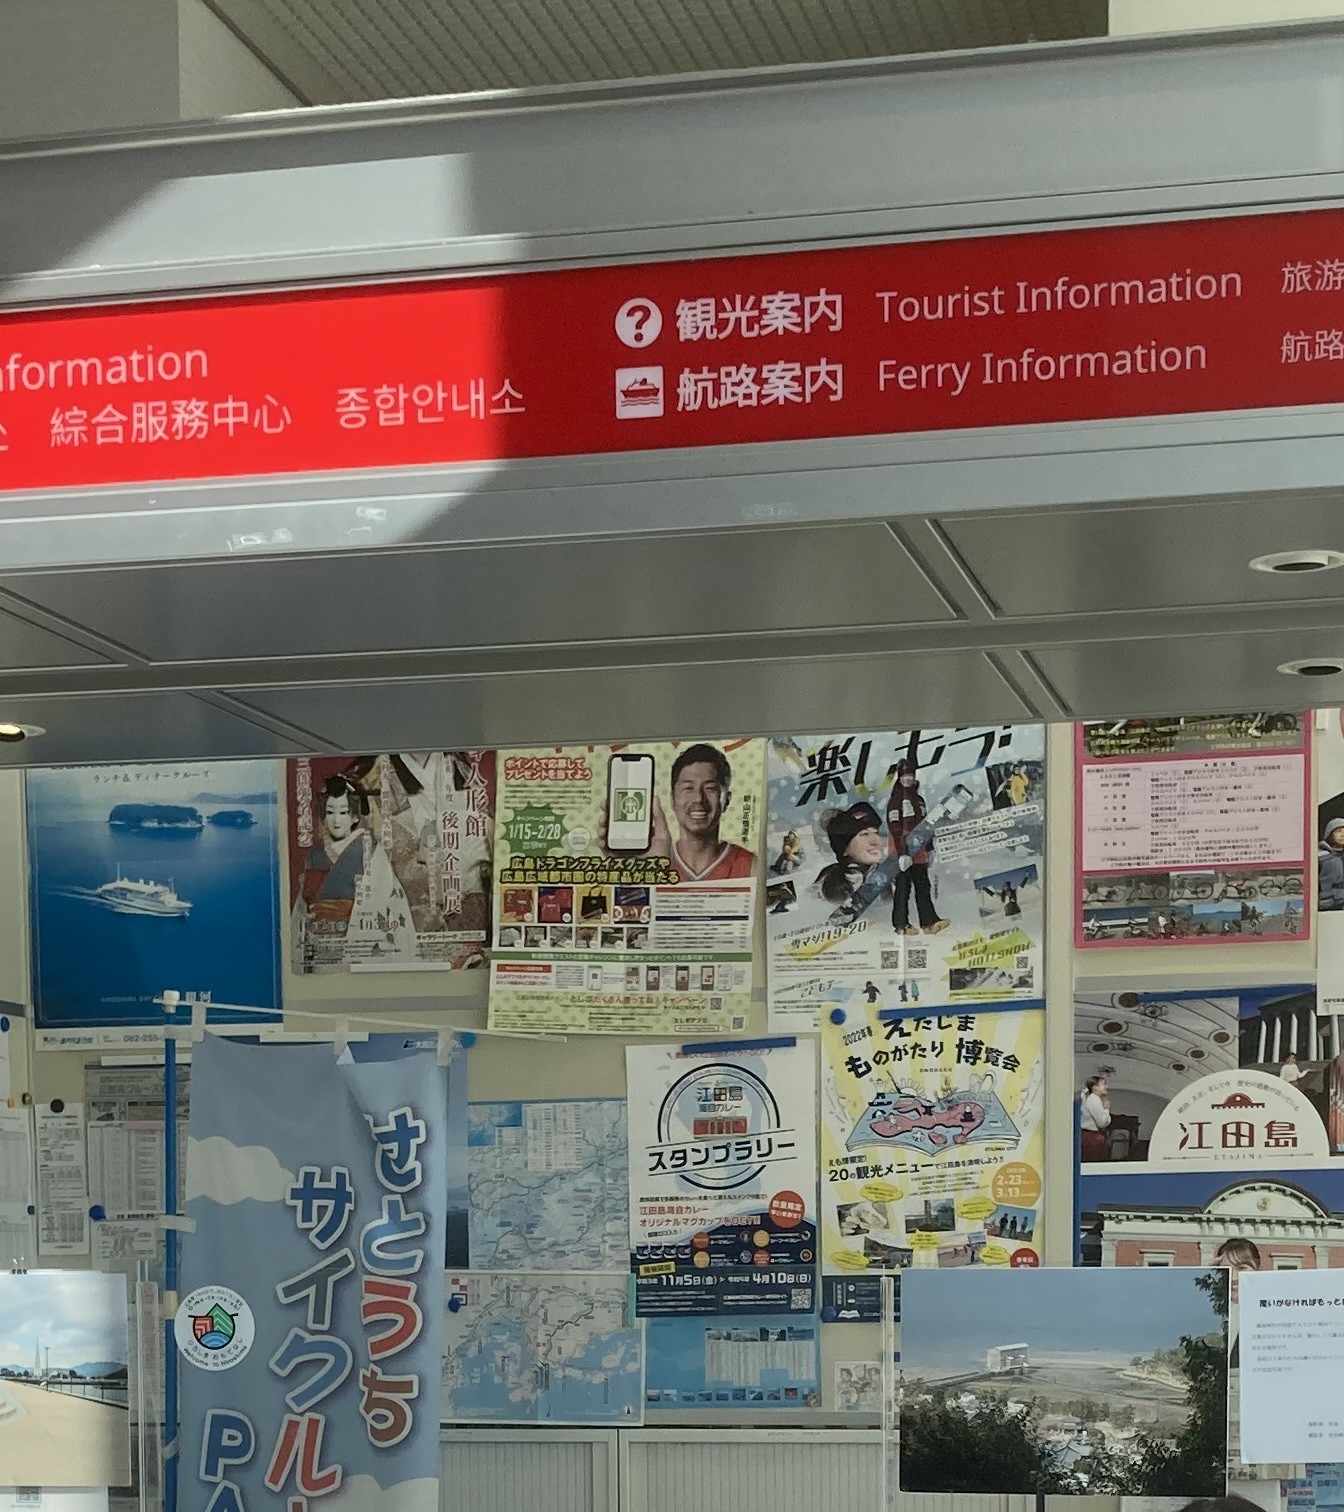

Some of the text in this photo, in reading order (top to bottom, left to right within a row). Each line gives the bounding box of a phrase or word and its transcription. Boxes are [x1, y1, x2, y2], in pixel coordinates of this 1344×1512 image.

[676, 288, 844, 343] 観光案内
[876, 267, 1242, 324] Tourist Information
[676, 359, 844, 413] 航路案内
[878, 339, 1207, 396] Ferry Information
[50, 396, 292, 449] 綜合服務中心
[336, 378, 527, 429] 종합안내소
[844, 1039, 1021, 1080] ものがたり 博覧会
[648, 1138, 796, 1172] スタンプラリー
[1178, 1120, 1298, 1151] 江田島
